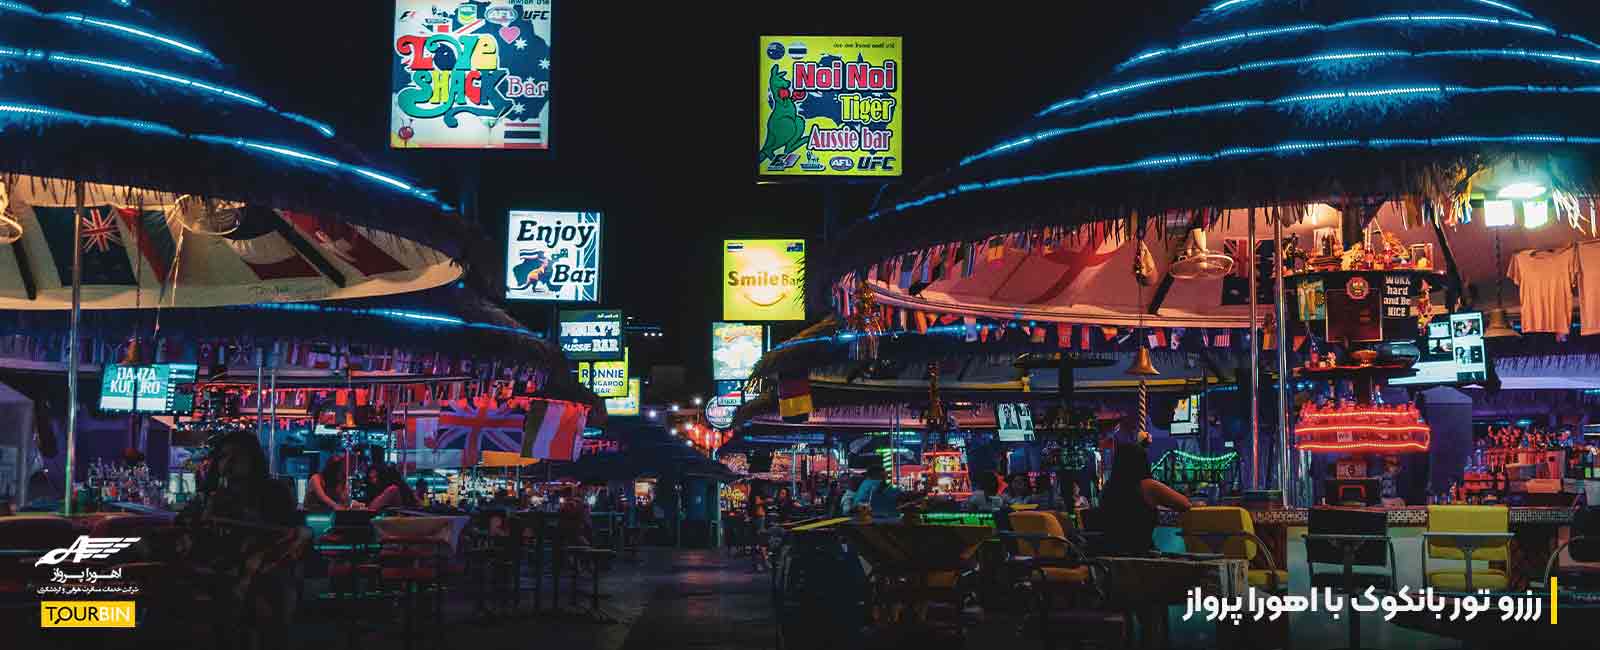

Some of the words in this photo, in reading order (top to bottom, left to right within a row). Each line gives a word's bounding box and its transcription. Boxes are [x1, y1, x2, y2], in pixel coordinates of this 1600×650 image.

[523, 10, 550, 19] UFC
[794, 61, 842, 89] Noi
[846, 61, 895, 89] Noi
[507, 75, 549, 98] Bar
[398, 70, 514, 127] SHACK
[839, 94, 894, 123] Tiger
[808, 125, 858, 150] Aussie
[861, 127, 892, 150] bar
[830, 159, 853, 167] AFL
[857, 157, 897, 170] UFC
[517, 220, 594, 248] Enjoy
[553, 264, 596, 283] Bar
[728, 271, 779, 287] Smile
[1387, 286, 1408, 295] hard
[1384, 297, 1399, 305] and
[1387, 307, 1406, 316] NICE
[562, 344, 592, 352] AUSSIE
[592, 339, 619, 352] BAR
